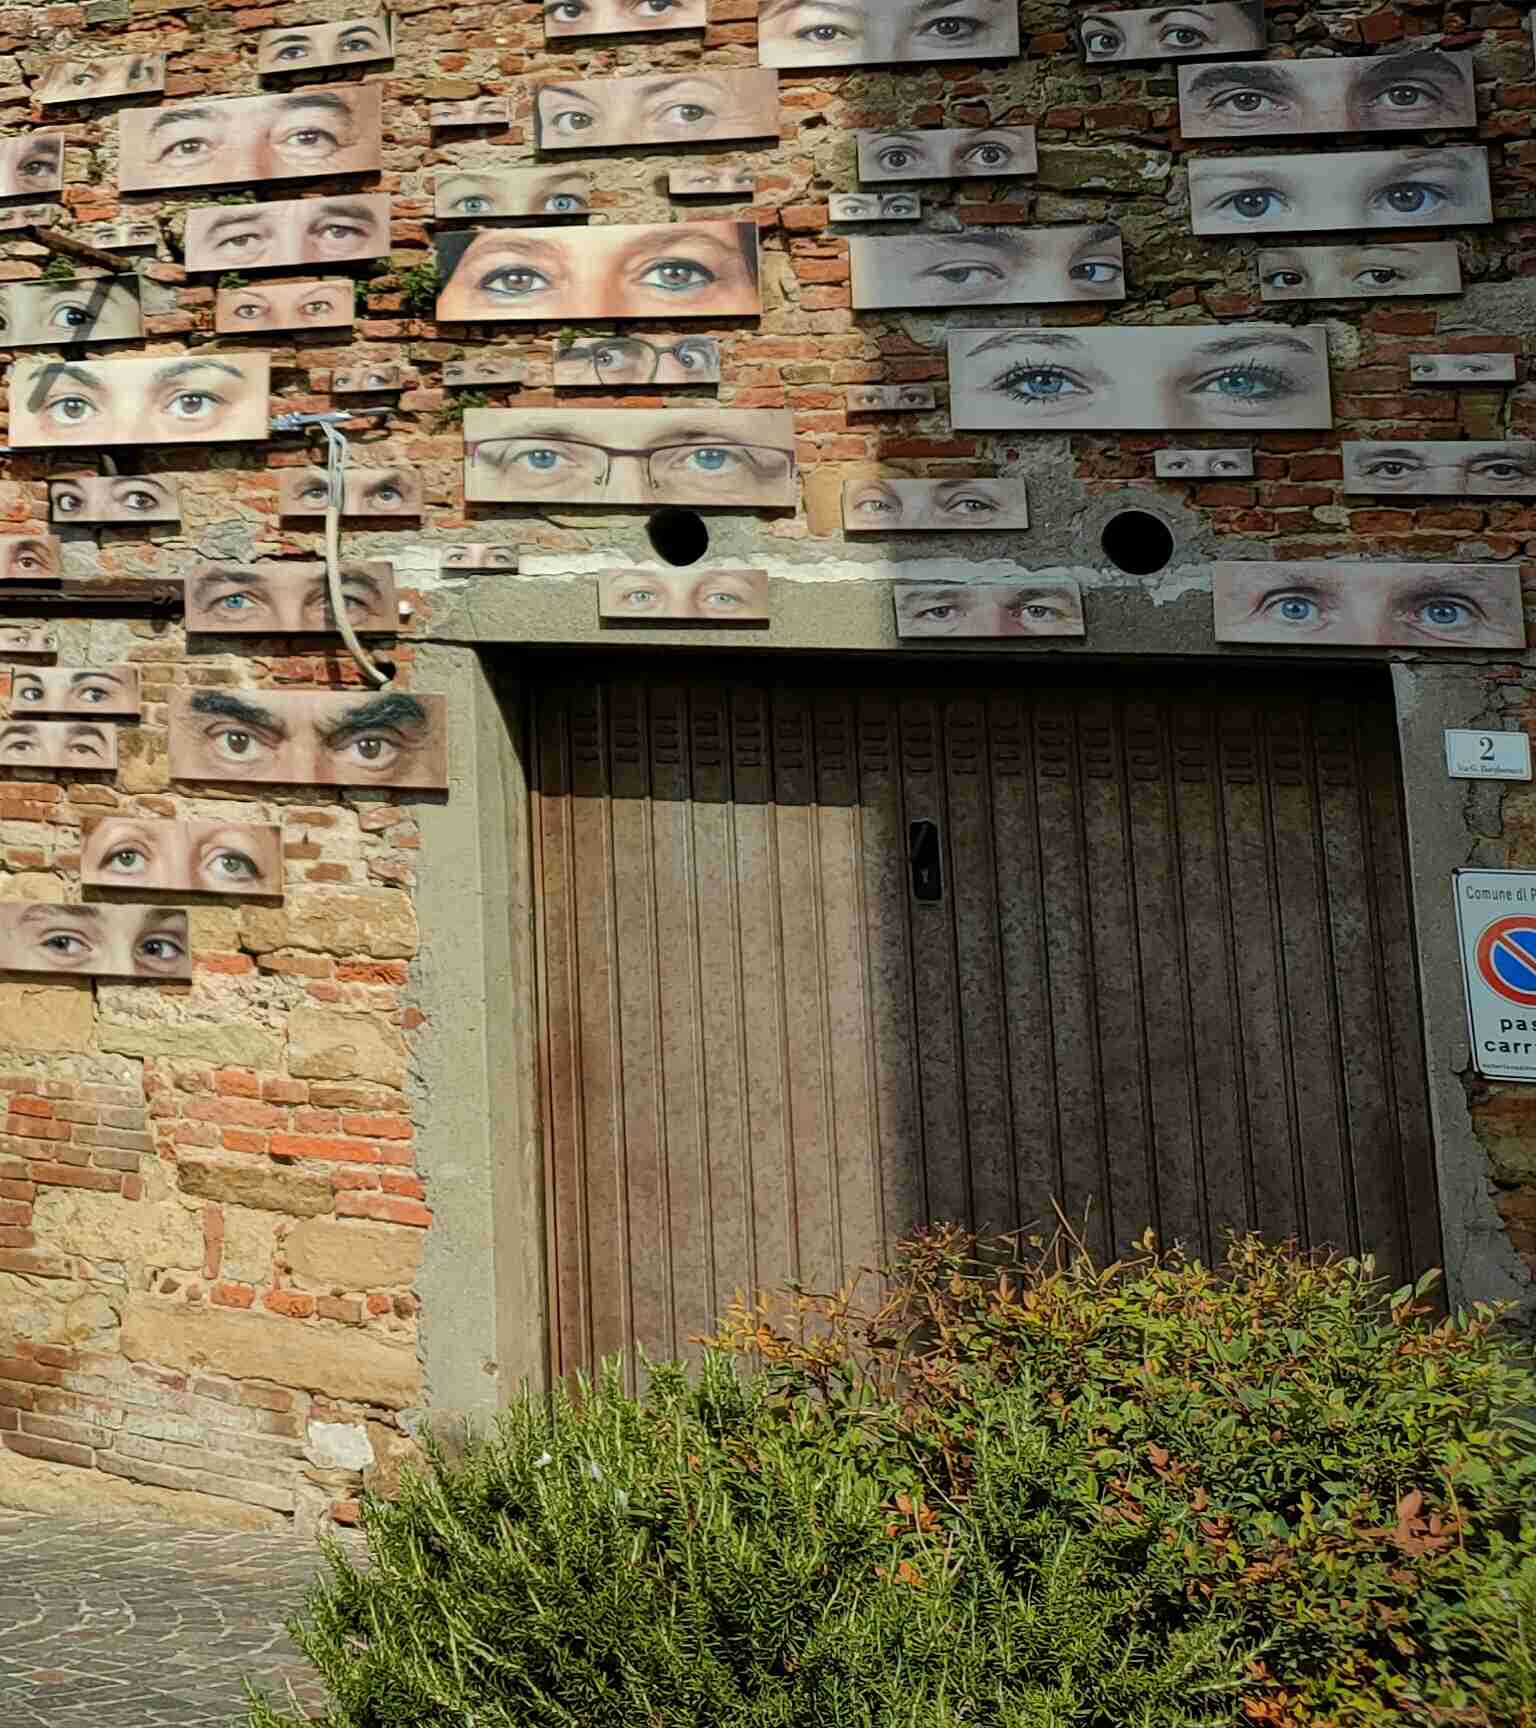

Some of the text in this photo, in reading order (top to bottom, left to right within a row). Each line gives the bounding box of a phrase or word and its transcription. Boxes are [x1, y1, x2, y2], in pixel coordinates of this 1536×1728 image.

[1479, 735, 1496, 761] 2
[1466, 885, 1513, 902] Comune
[1516, 887, 1528, 902] di
